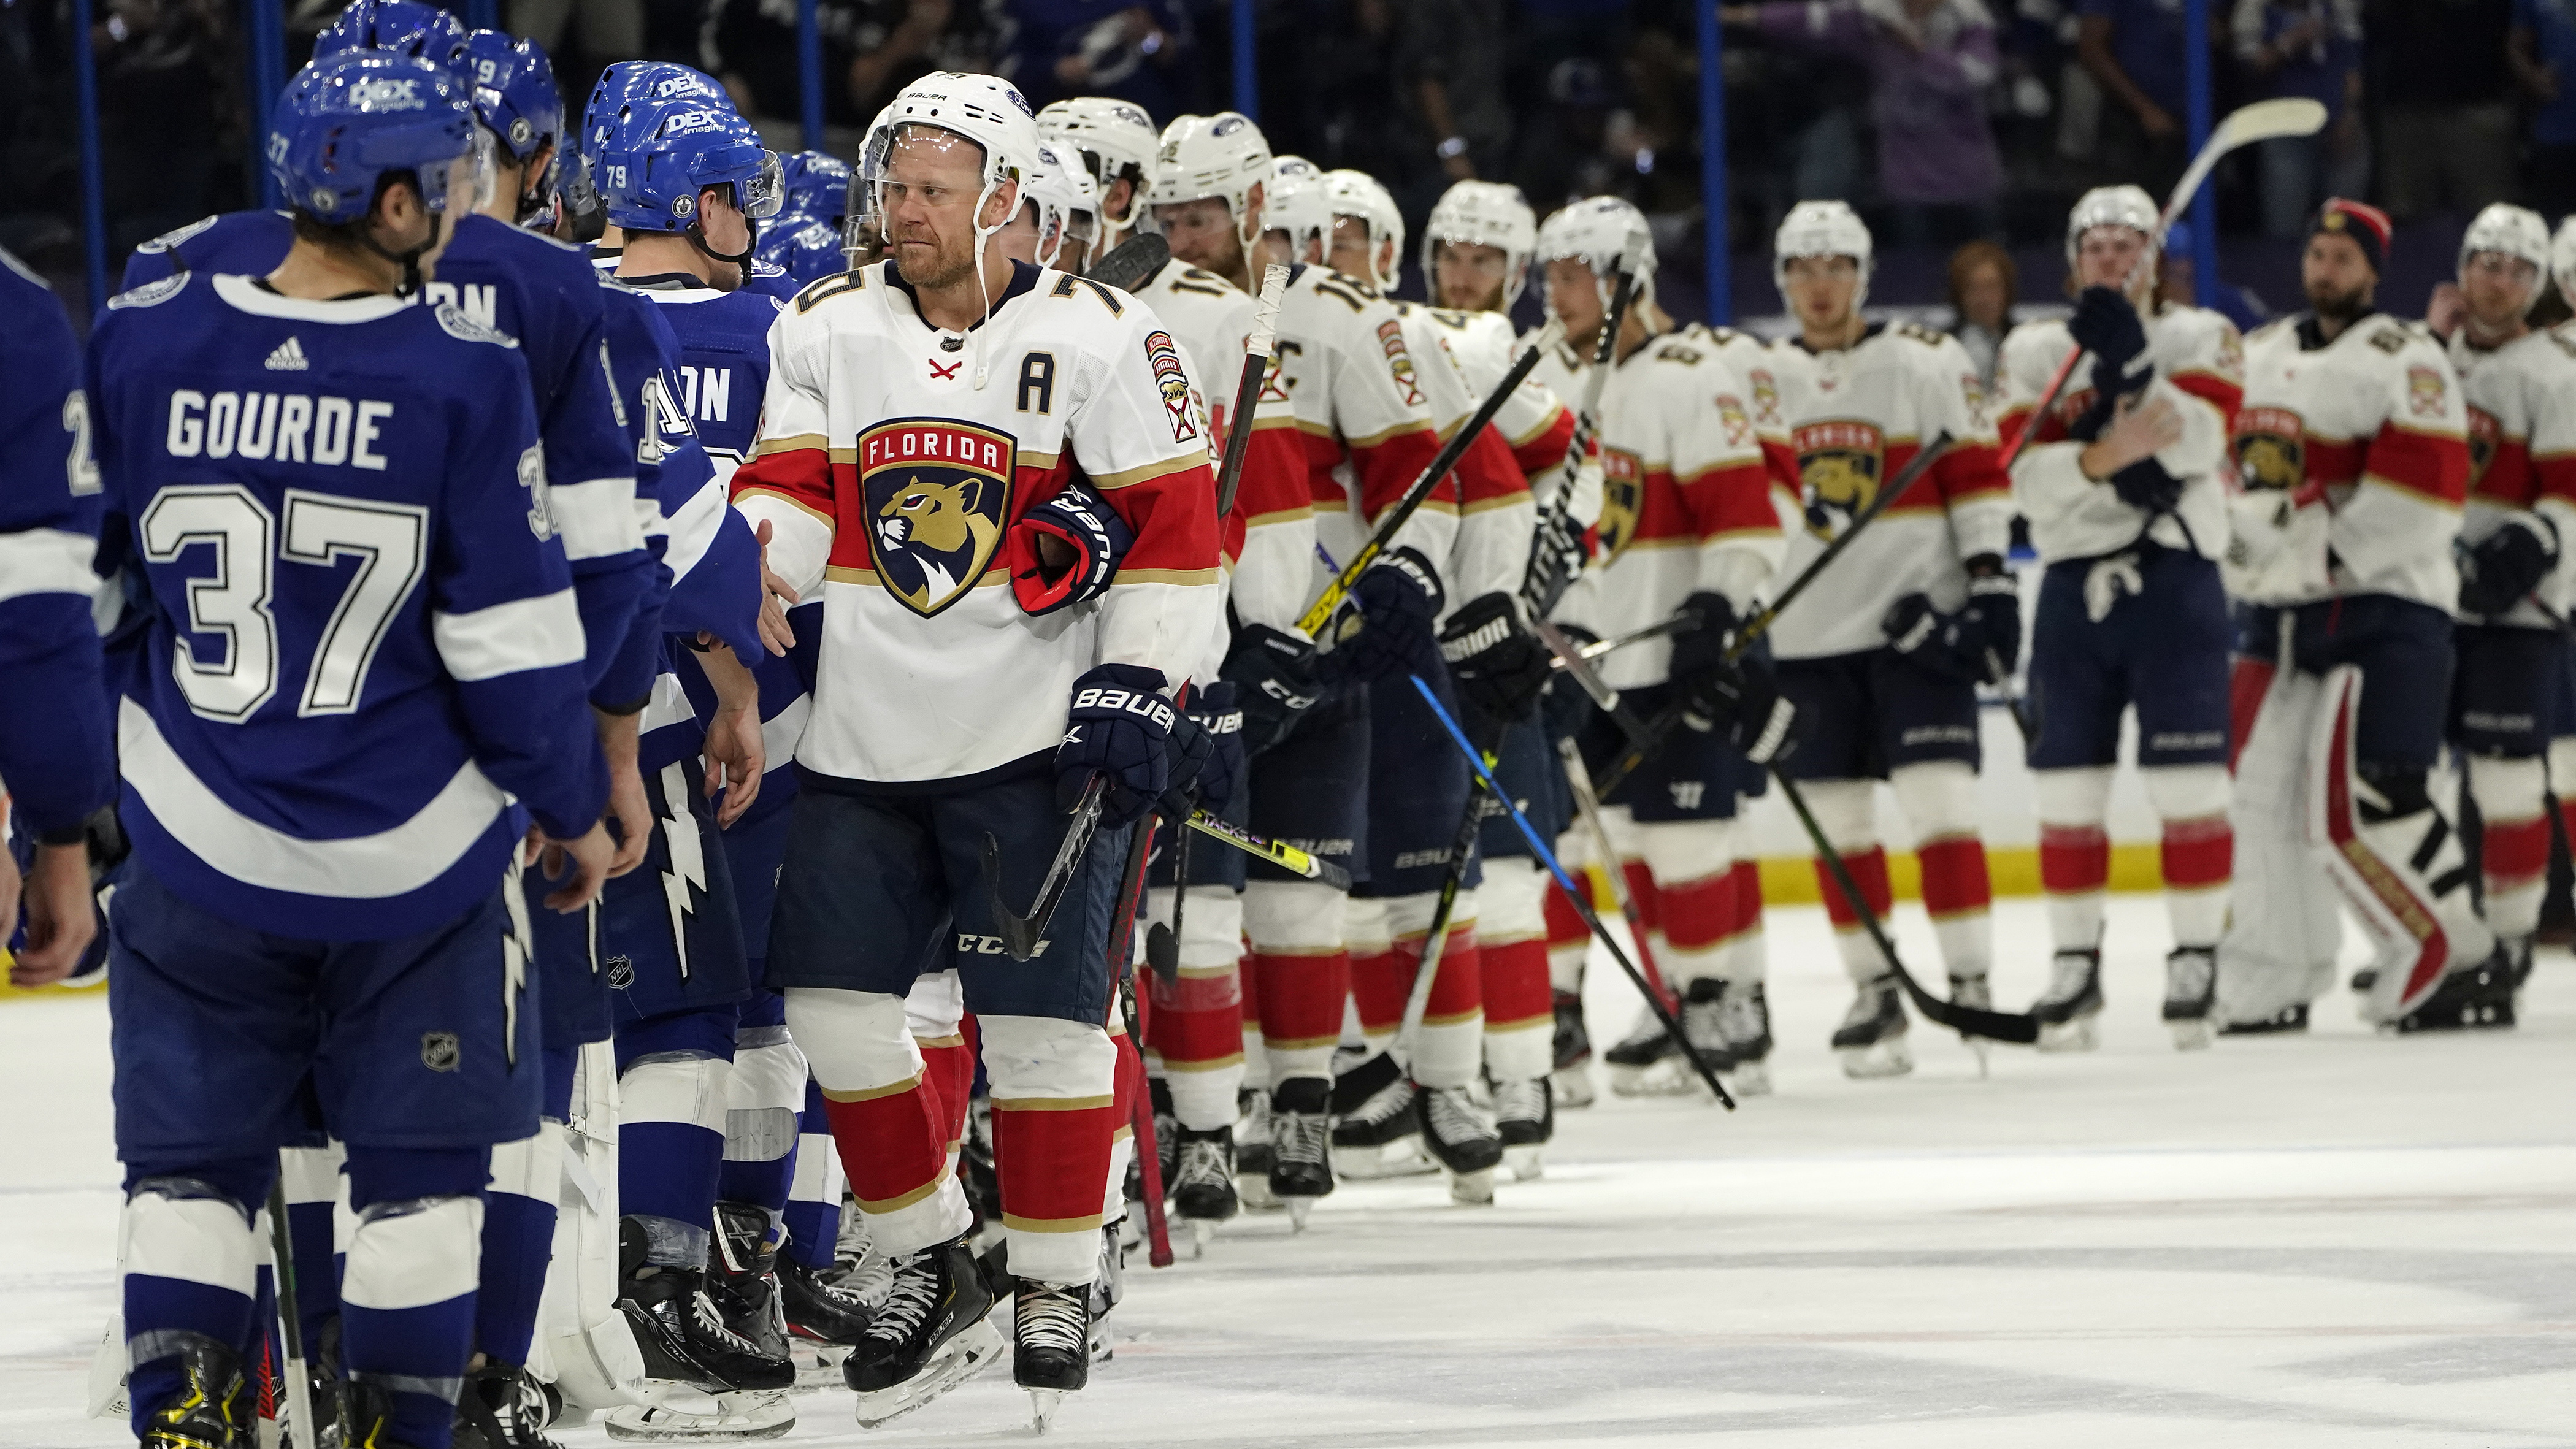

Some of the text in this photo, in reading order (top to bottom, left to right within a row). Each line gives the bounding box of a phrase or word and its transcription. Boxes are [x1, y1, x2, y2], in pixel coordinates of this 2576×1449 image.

[659, 74, 699, 97] DEX
[668, 110, 719, 132] DEX
[684, 124, 726, 135] imaging
[606, 165, 627, 189] 79
[1049, 273, 1125, 320] 7
[1155, 359, 1177, 375] PANTHERS
[1016, 350, 1057, 416] A
[166, 389, 394, 471] GOURDE
[869, 433, 997, 468] FLORIDA
[139, 483, 430, 725] 37
[610, 964, 627, 984] NHL
[928, 1311, 954, 1348] BAUER
